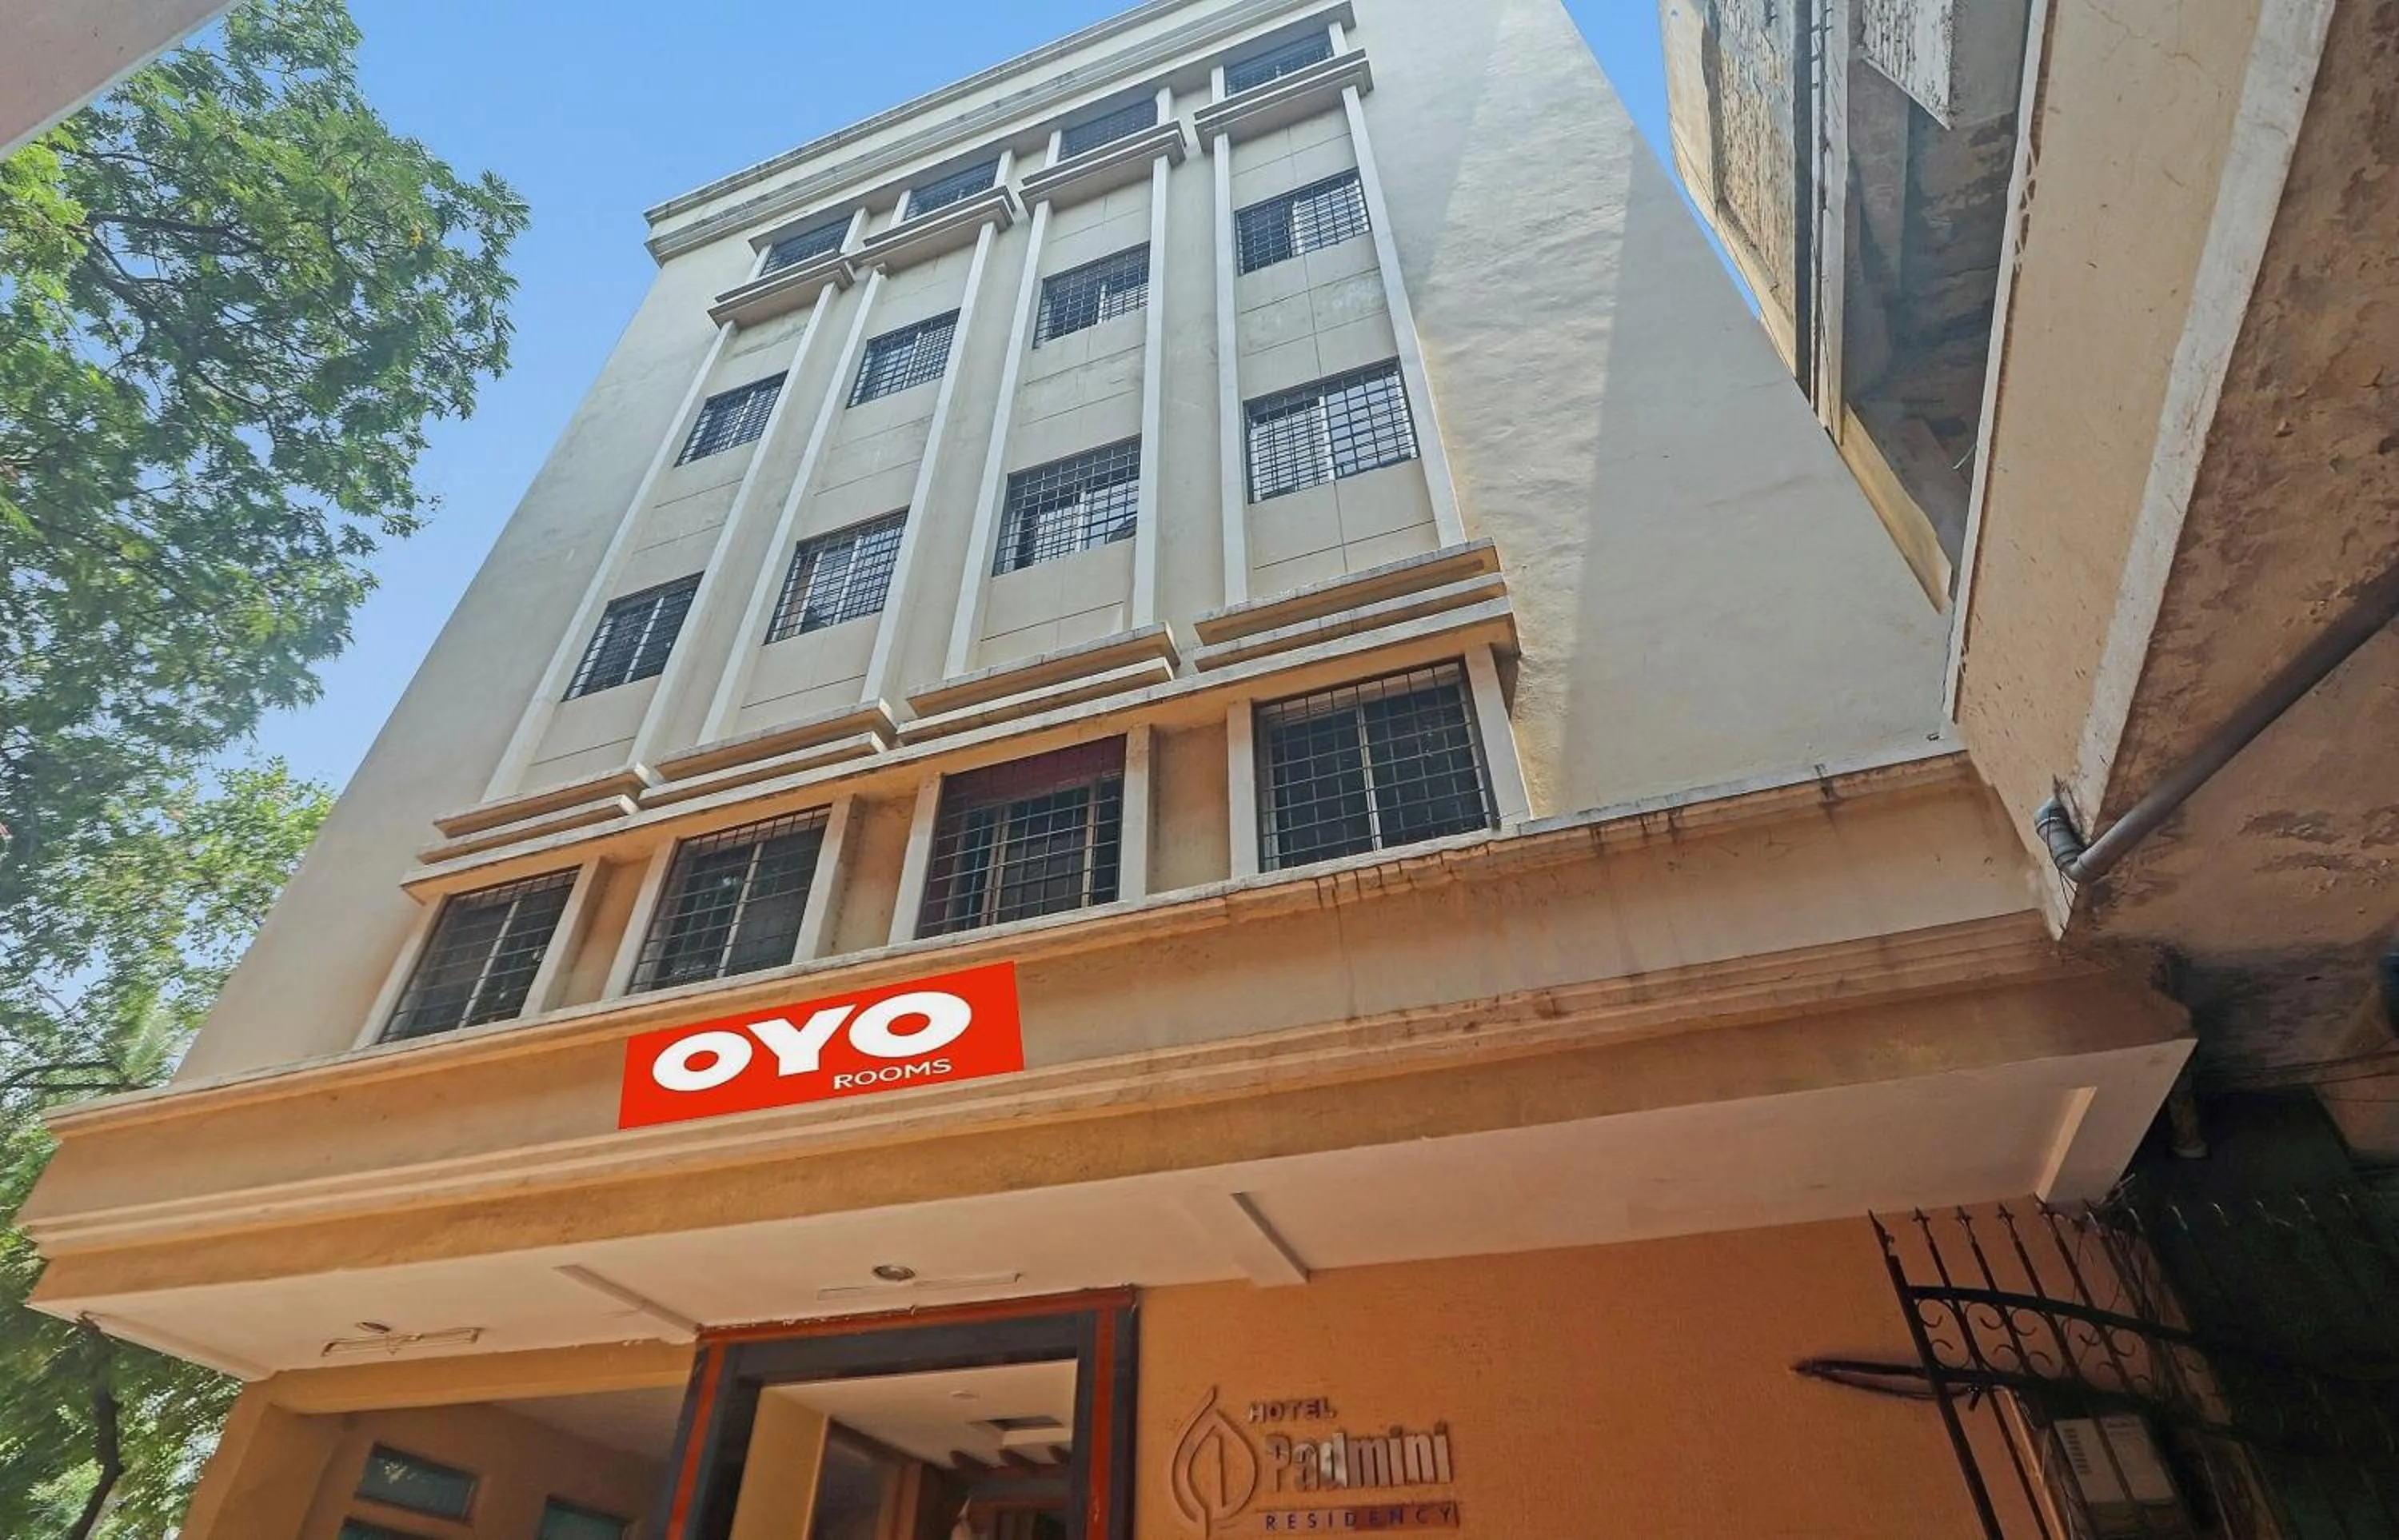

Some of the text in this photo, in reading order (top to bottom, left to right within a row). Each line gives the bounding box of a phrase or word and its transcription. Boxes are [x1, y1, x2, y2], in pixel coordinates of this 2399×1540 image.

[652, 991, 972, 1092] OYO
[832, 1058, 952, 1090] ROOMS
[1248, 1396, 1337, 1422] HOTEL
[1264, 1421, 1453, 1493] Padmini
[1266, 1507, 1452, 1531] RESIDENCY
